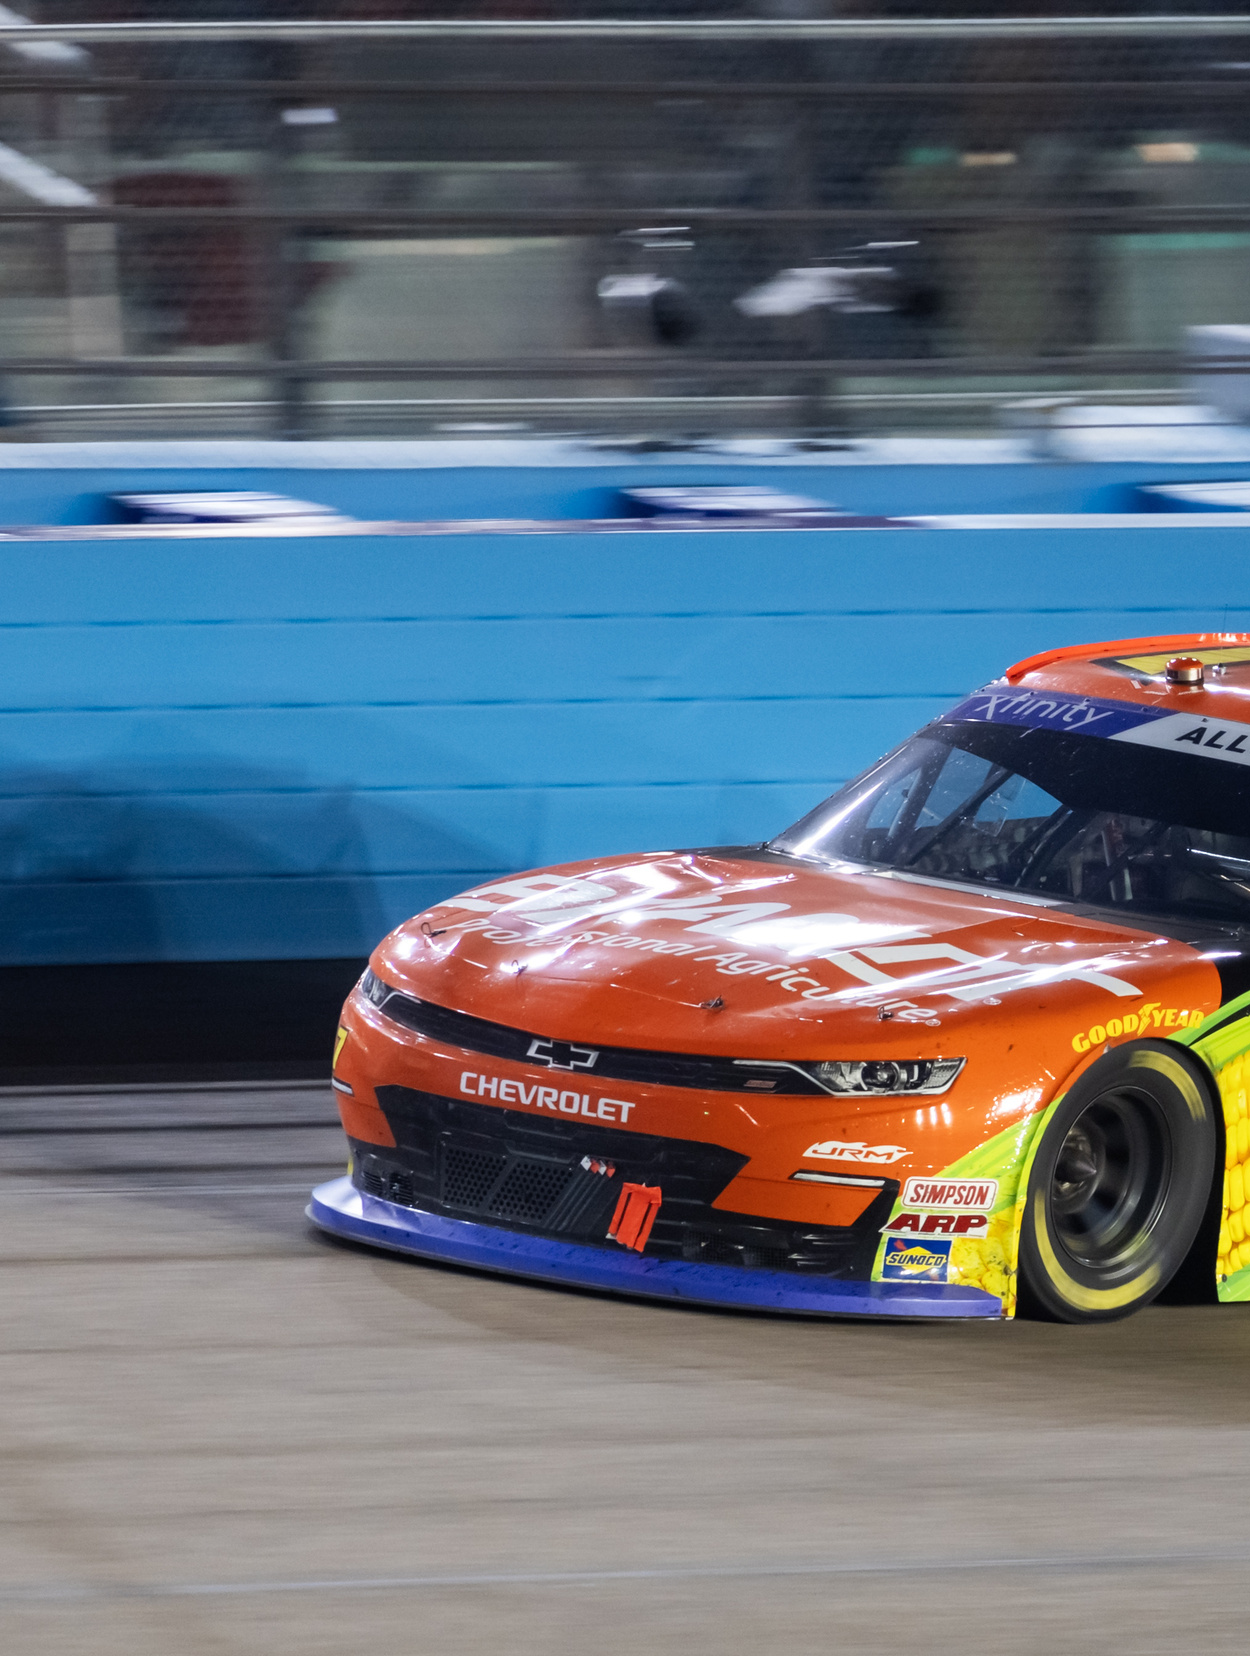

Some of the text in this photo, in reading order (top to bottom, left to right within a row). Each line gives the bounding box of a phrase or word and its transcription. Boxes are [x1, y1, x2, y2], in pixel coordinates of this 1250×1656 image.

[972, 691, 1115, 731] xfinity
[693, 951, 938, 1020] Agricuure
[460, 1071, 636, 1123] CHEVROLET
[811, 1147, 895, 1161] JRM
[910, 1183, 990, 1206] SIMPSON
[884, 1213, 988, 1234] ARP
[888, 1253, 945, 1267] SUNOCO
